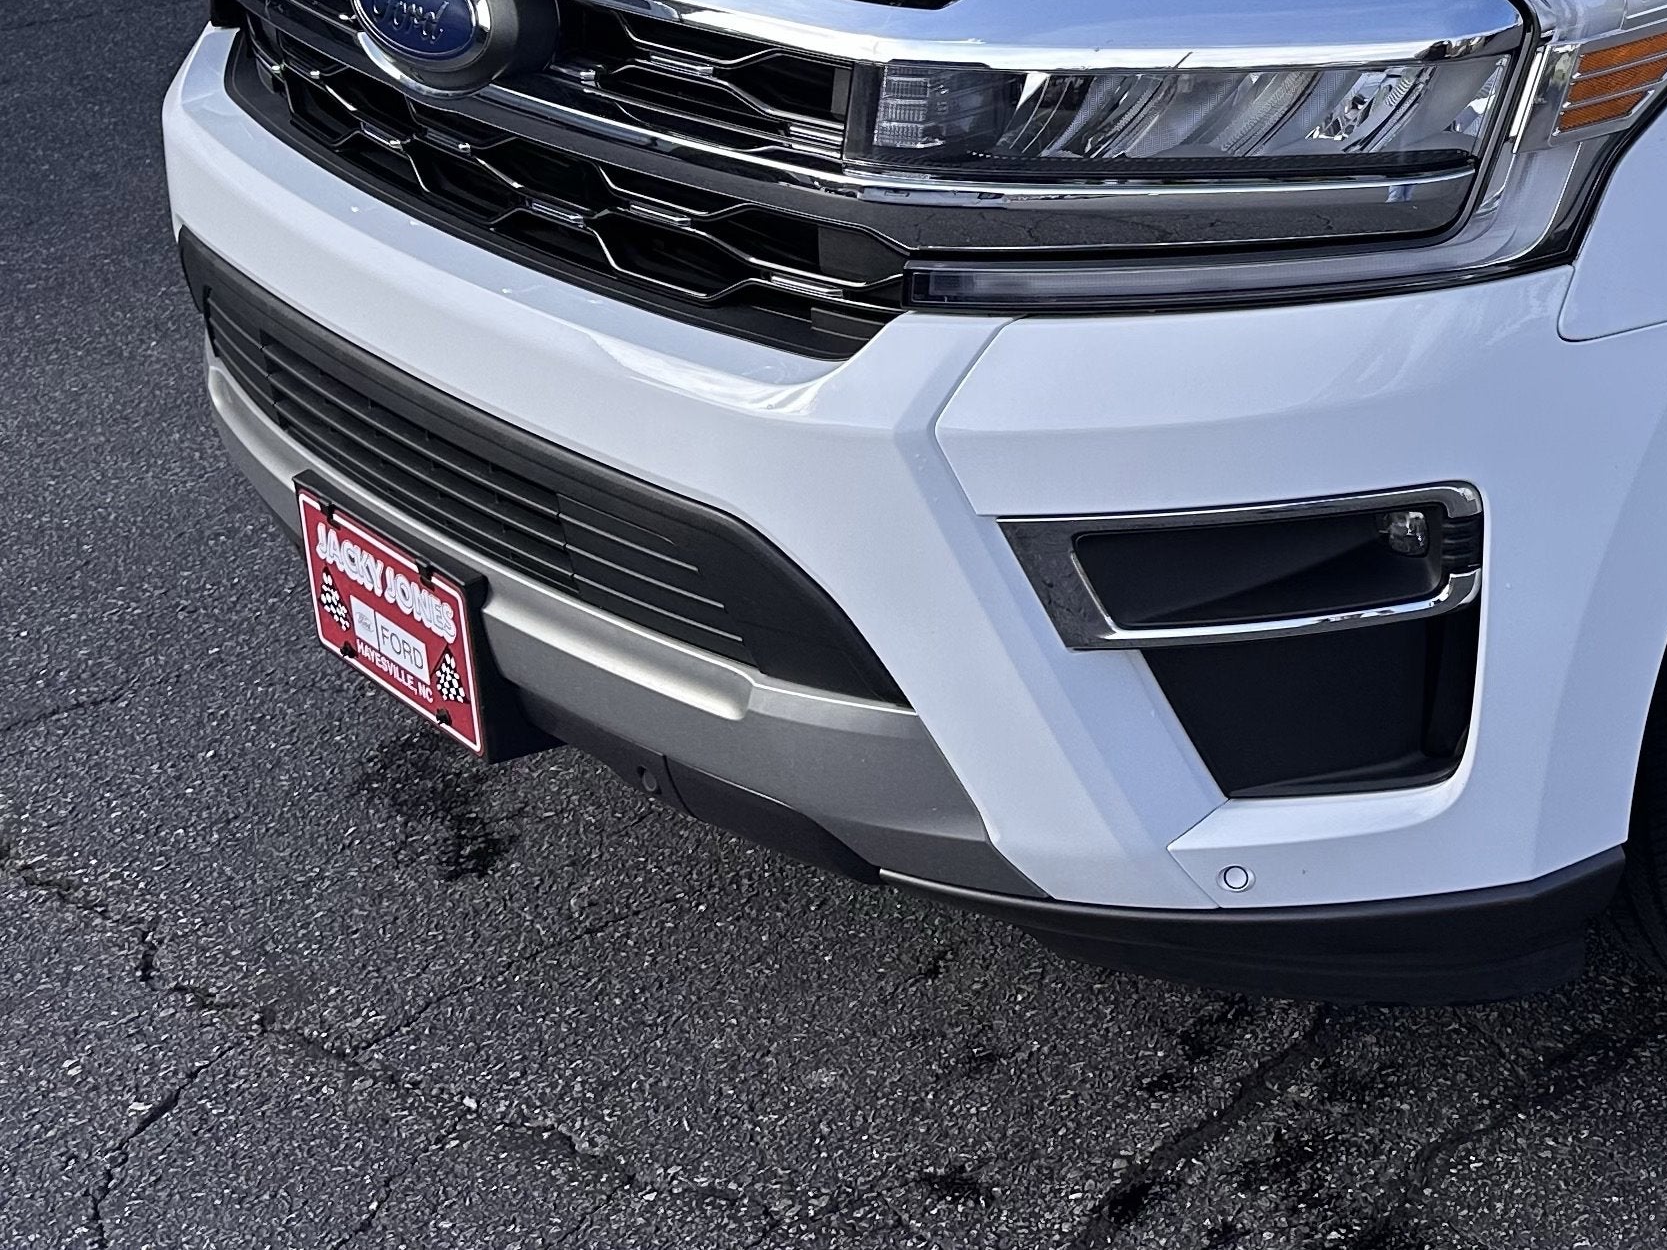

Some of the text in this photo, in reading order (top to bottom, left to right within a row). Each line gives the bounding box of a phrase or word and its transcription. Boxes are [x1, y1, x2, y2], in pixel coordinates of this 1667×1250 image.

[316, 522, 457, 644] JACKY JONES
[356, 638, 434, 704] HAYESVILLE, NC
[380, 625, 424, 670] FORD
